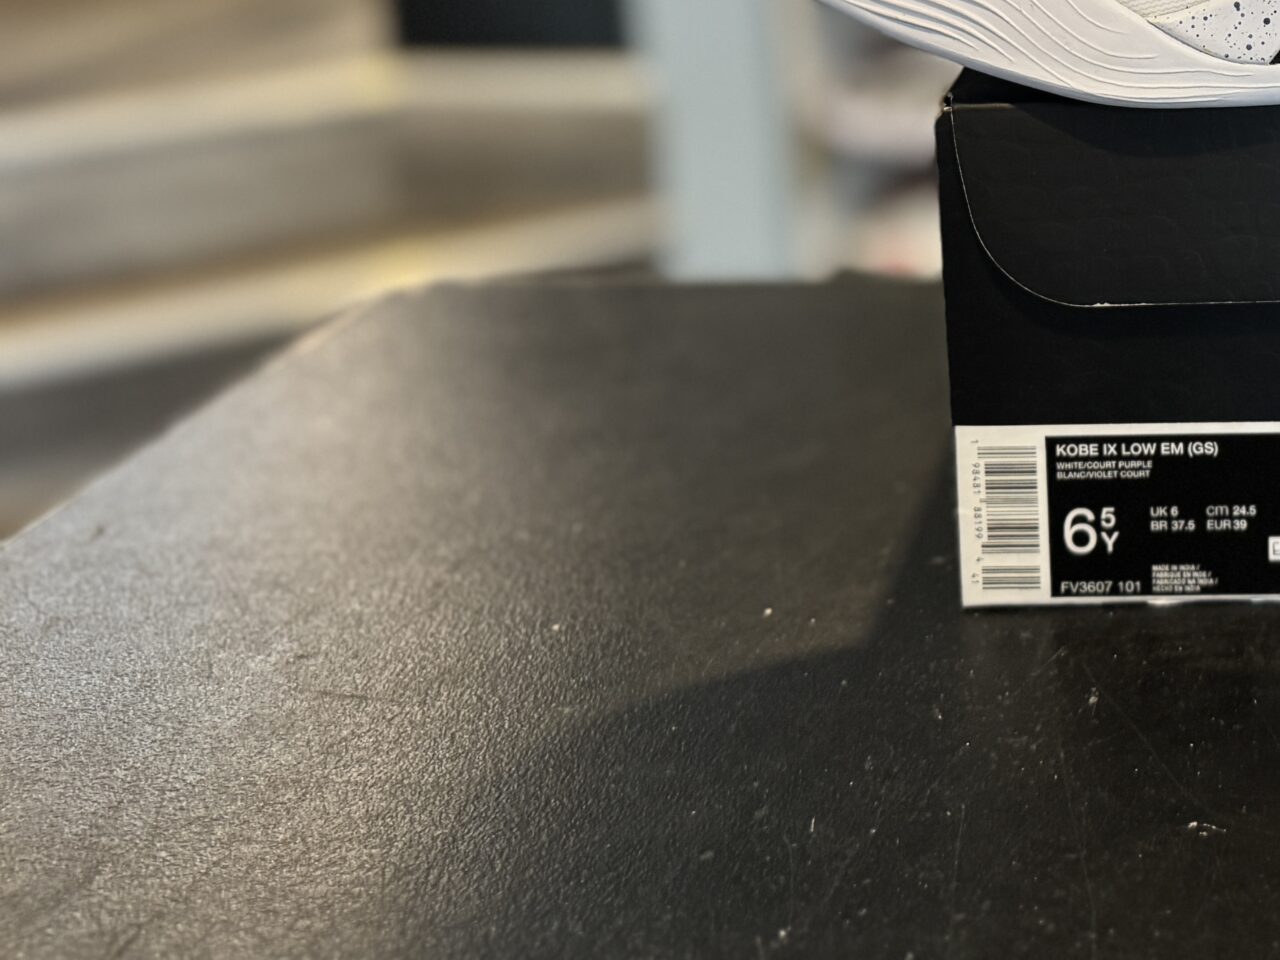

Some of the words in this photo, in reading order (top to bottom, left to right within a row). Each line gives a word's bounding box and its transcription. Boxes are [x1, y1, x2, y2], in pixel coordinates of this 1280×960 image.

[1055, 443, 1099, 457] KOBE
[1102, 442, 1118, 456] IX
[1121, 442, 1157, 455] LOW
[1160, 442, 1184, 455] EM
[1187, 441, 1219, 458] (GS)
[1055, 460, 1117, 470] WHITE/COURT
[1118, 460, 1153, 469] PURPLE
[1056, 470, 1118, 480] BLANC/VIOLET
[1119, 469, 1151, 478] COURT
[1150, 506, 1168, 517] UK
[1170, 505, 1179, 517] 6
[1232, 504, 1257, 516] 24.5
[1100, 506, 1117, 529] 5
[1062, 506, 1098, 555] 6
[1150, 520, 1168, 531] BR
[1170, 519, 1196, 530] 37.5
[1206, 519, 1232, 530] EUR
[1233, 519, 1248, 530] 39
[1101, 531, 1119, 554] Y
[1060, 581, 1112, 593] FV3607
[1117, 581, 1142, 593] 101
